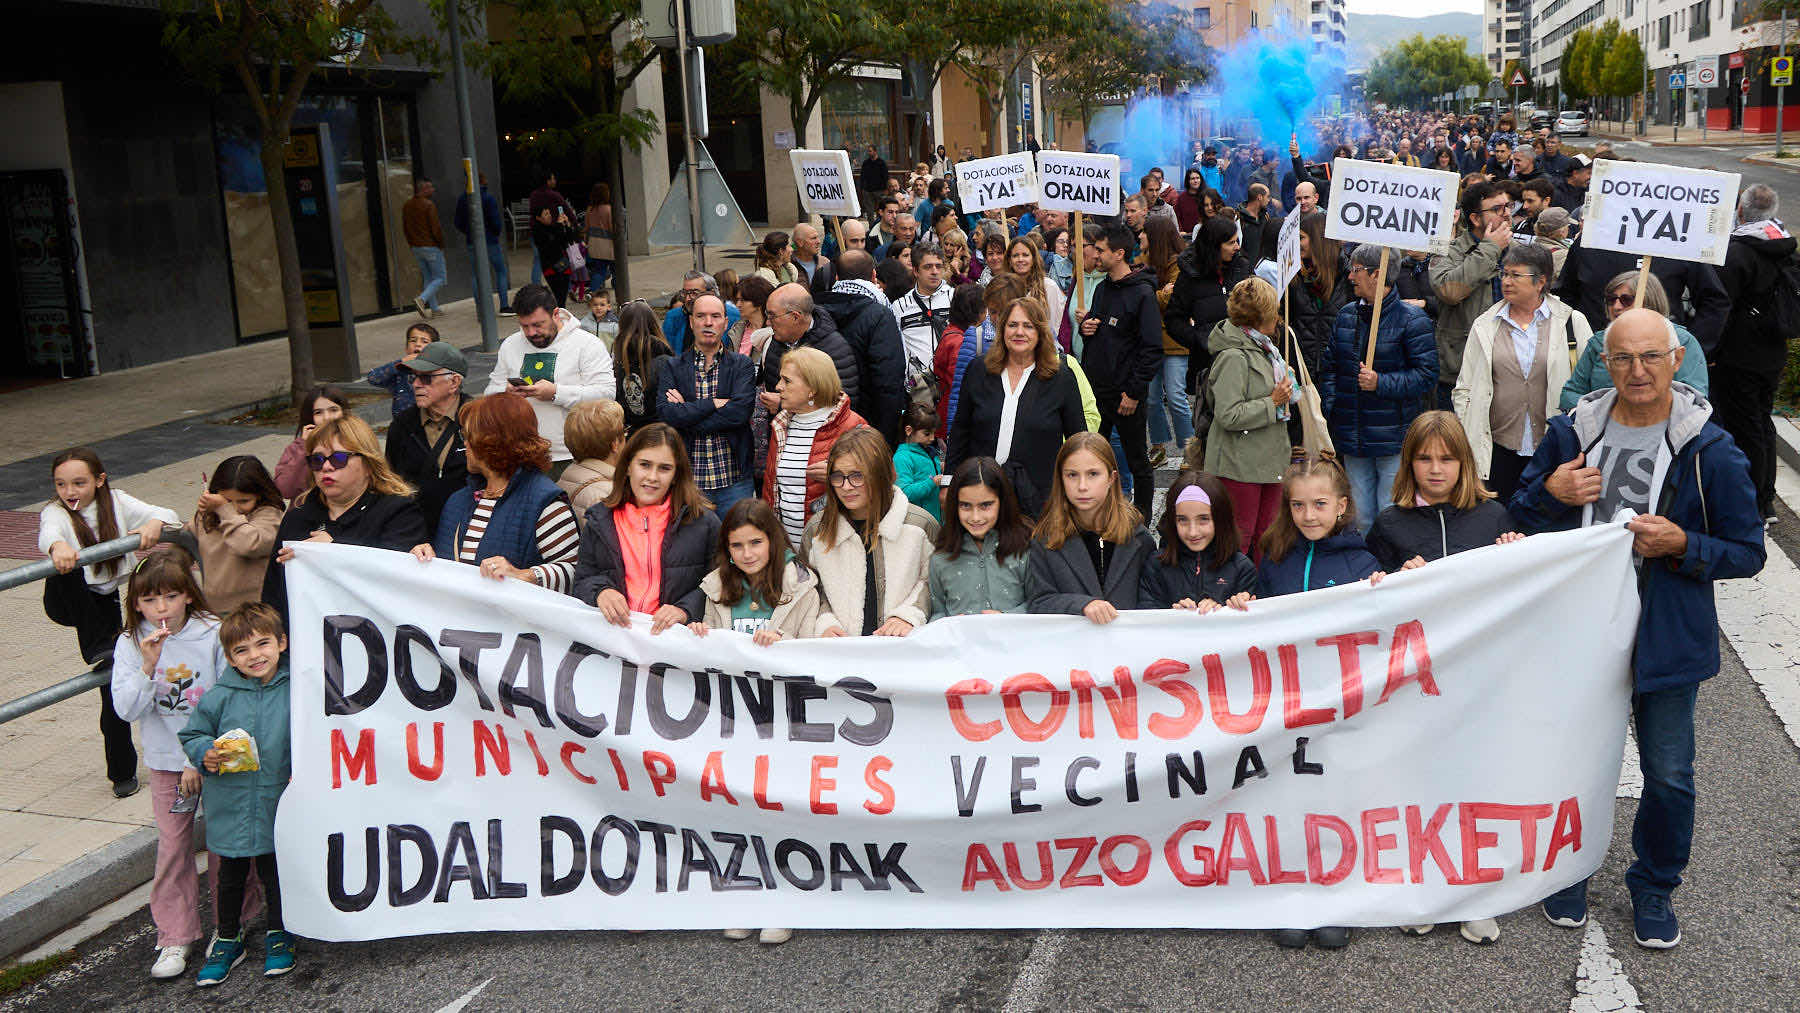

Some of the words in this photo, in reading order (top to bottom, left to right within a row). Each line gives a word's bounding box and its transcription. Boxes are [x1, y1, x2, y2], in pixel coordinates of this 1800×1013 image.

[802, 167, 839, 177] DOTAZIOAK
[963, 164, 1025, 180] DOTACIONES
[1044, 163, 1110, 179] DOTAZIOAK
[807, 183, 845, 200] ORAIN!
[978, 180, 1015, 206] ¡YA!
[1044, 181, 1110, 205] ORAIN!
[1344, 177, 1442, 202] DOTAZIOAK
[1601, 179, 1720, 205] DOTACIONES
[1341, 202, 1439, 236] ORAIN!
[1617, 207, 1691, 245] ¡YA!
[323, 614, 894, 747] DOTACIONES
[945, 619, 1441, 742] CONSULTA
[330, 719, 895, 816] MUNICIPALES
[951, 736, 1324, 818] VECINAL
[326, 818, 528, 913] UDAL
[539, 814, 925, 898] DOTAZIOAK
[961, 834, 1153, 892] AUZO
[1163, 796, 1583, 889] GALDEKETA
